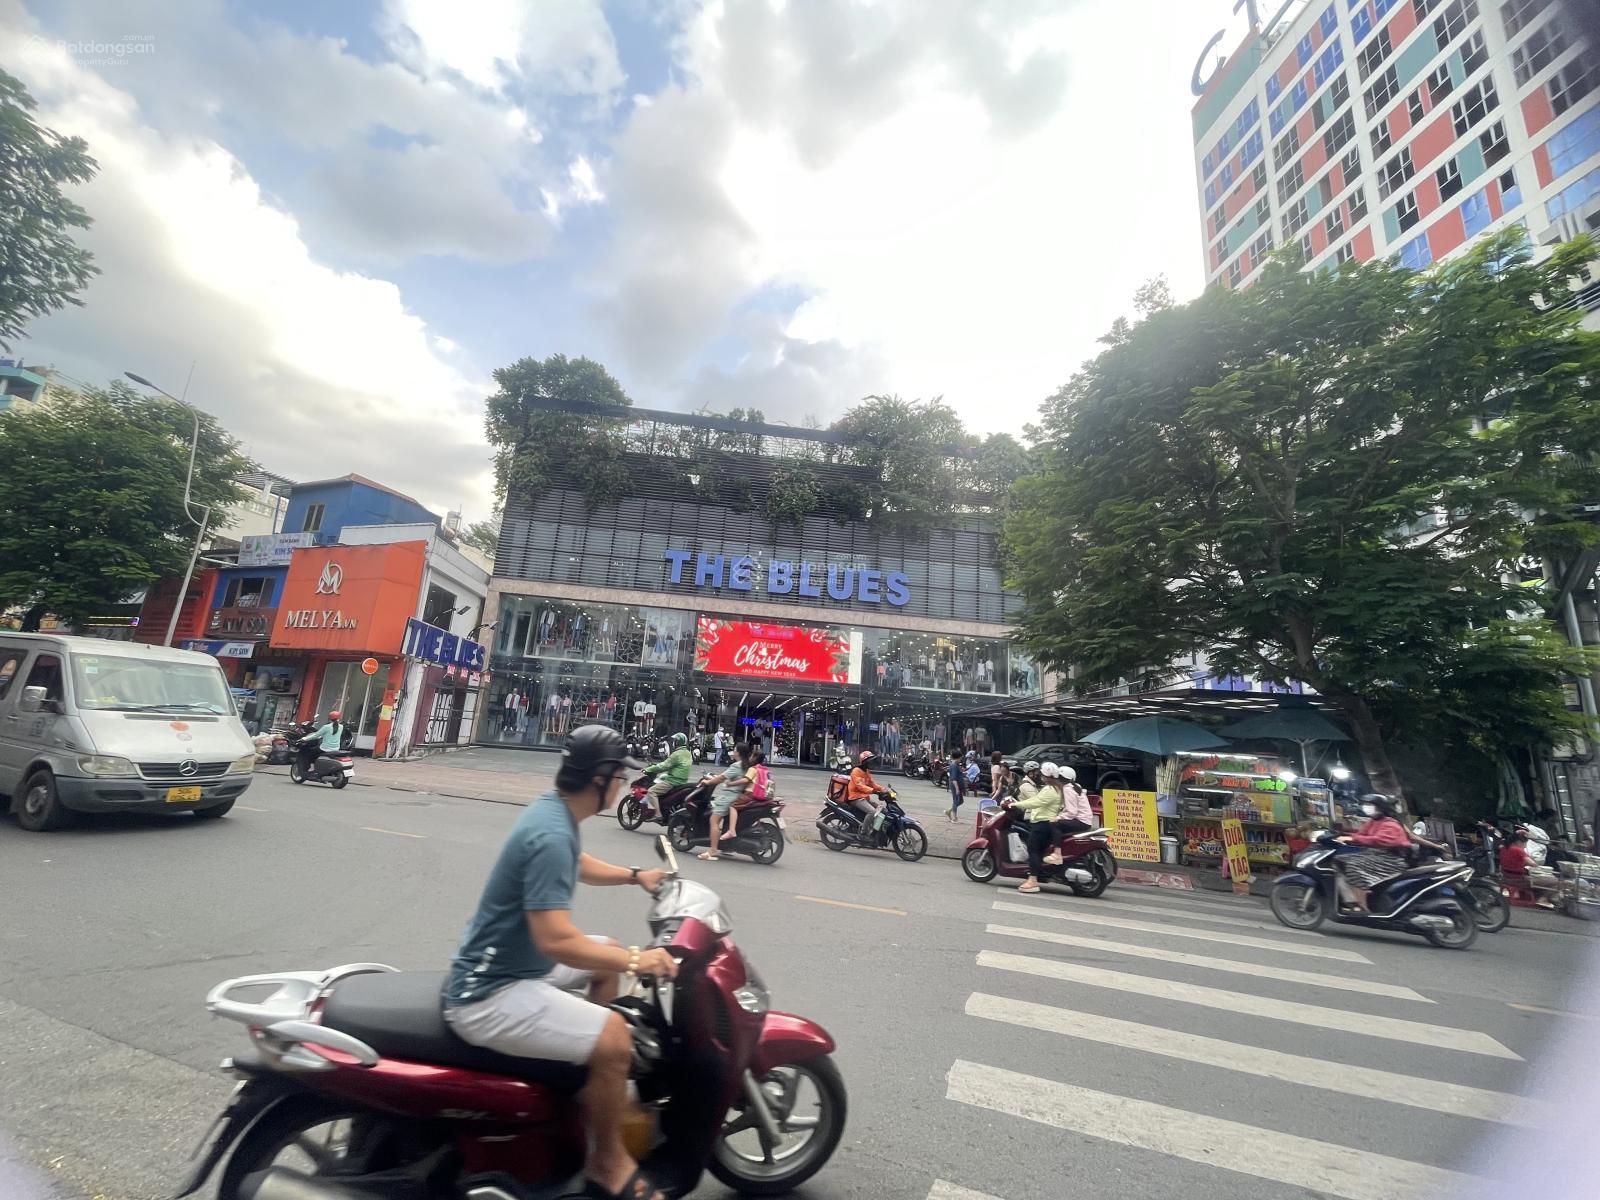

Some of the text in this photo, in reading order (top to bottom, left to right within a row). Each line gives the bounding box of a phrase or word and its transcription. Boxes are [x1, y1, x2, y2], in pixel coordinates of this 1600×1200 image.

[664, 550, 912, 606] THE BLUES
[734, 641, 811, 673] Christmas
